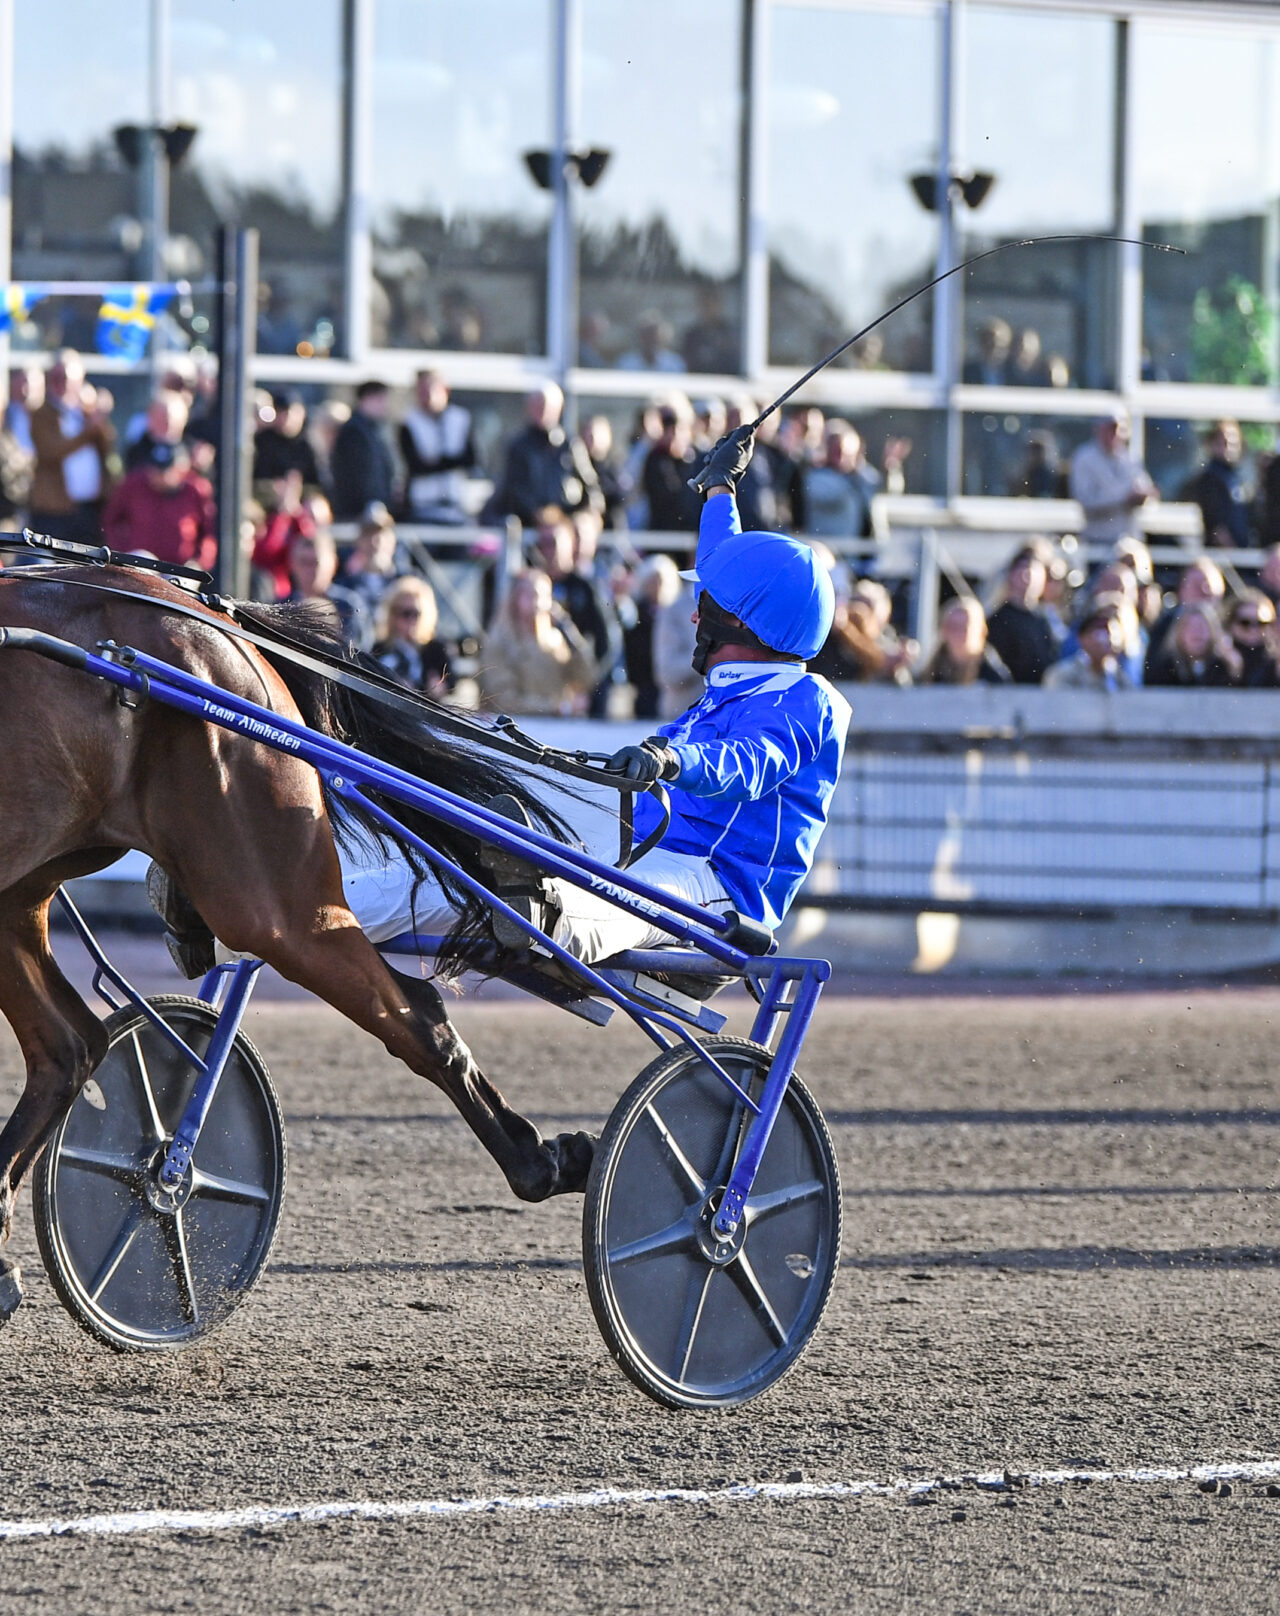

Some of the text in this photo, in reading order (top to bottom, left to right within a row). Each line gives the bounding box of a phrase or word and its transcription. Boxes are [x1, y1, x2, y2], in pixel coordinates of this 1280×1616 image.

[204, 699, 301, 750] Team Almheden
[590, 874, 661, 918] YANKEE
